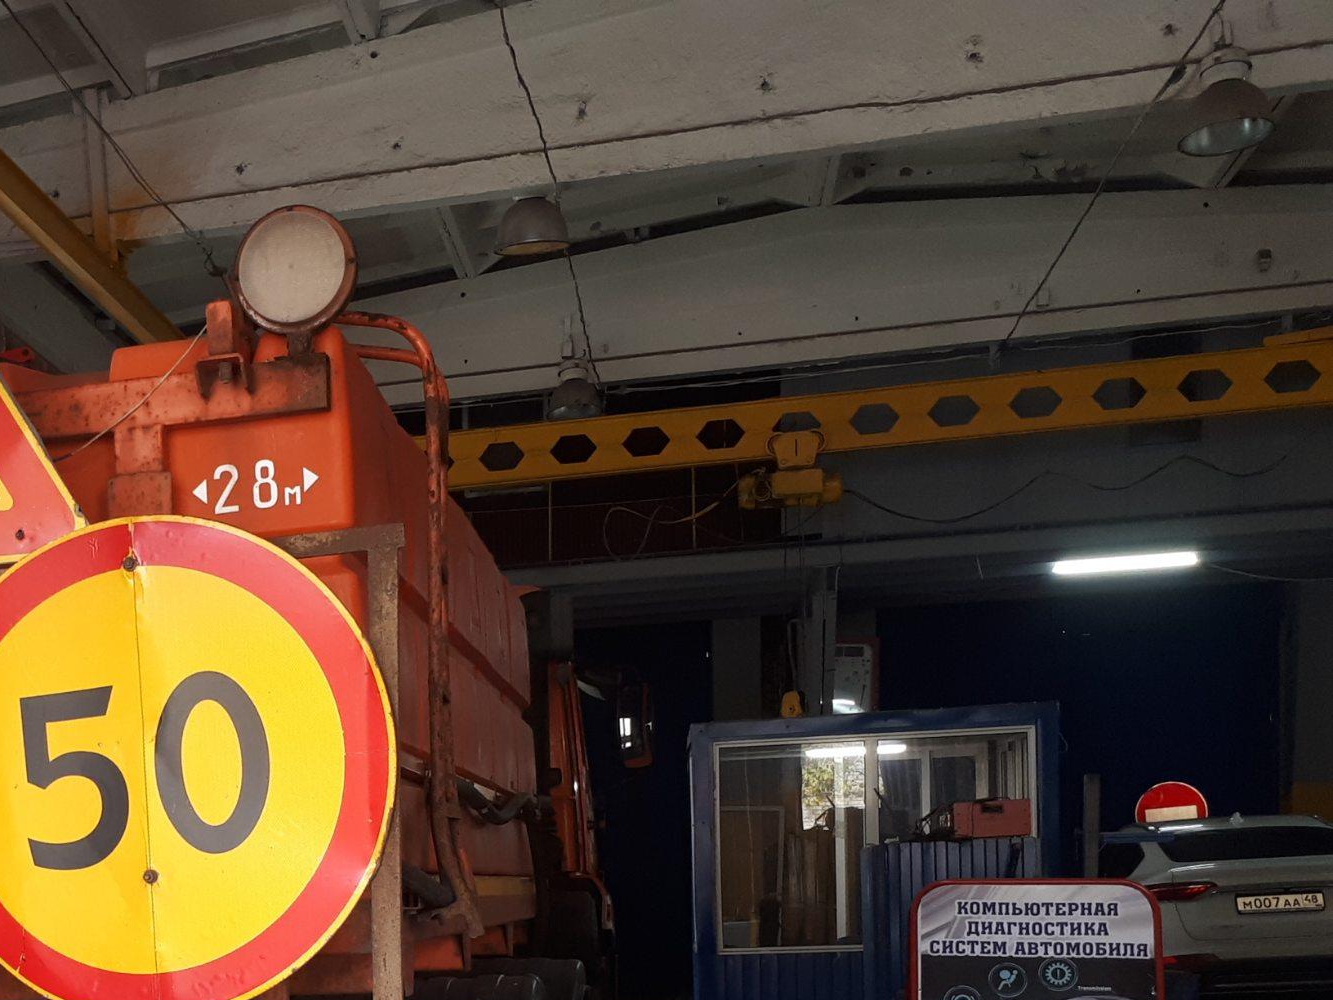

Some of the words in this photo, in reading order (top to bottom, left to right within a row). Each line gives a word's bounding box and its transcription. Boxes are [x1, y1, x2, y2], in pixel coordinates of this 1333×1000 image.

[20, 671, 270, 870] 50
[957, 901, 1119, 917] КОМПЬЮТЕРНАЯ
[966, 921, 1110, 938] ДИАГНОСТИКА
[929, 940, 1008, 955] СИСТЕМ
[1015, 941, 1150, 958] АВТОМОБИЛЯ
